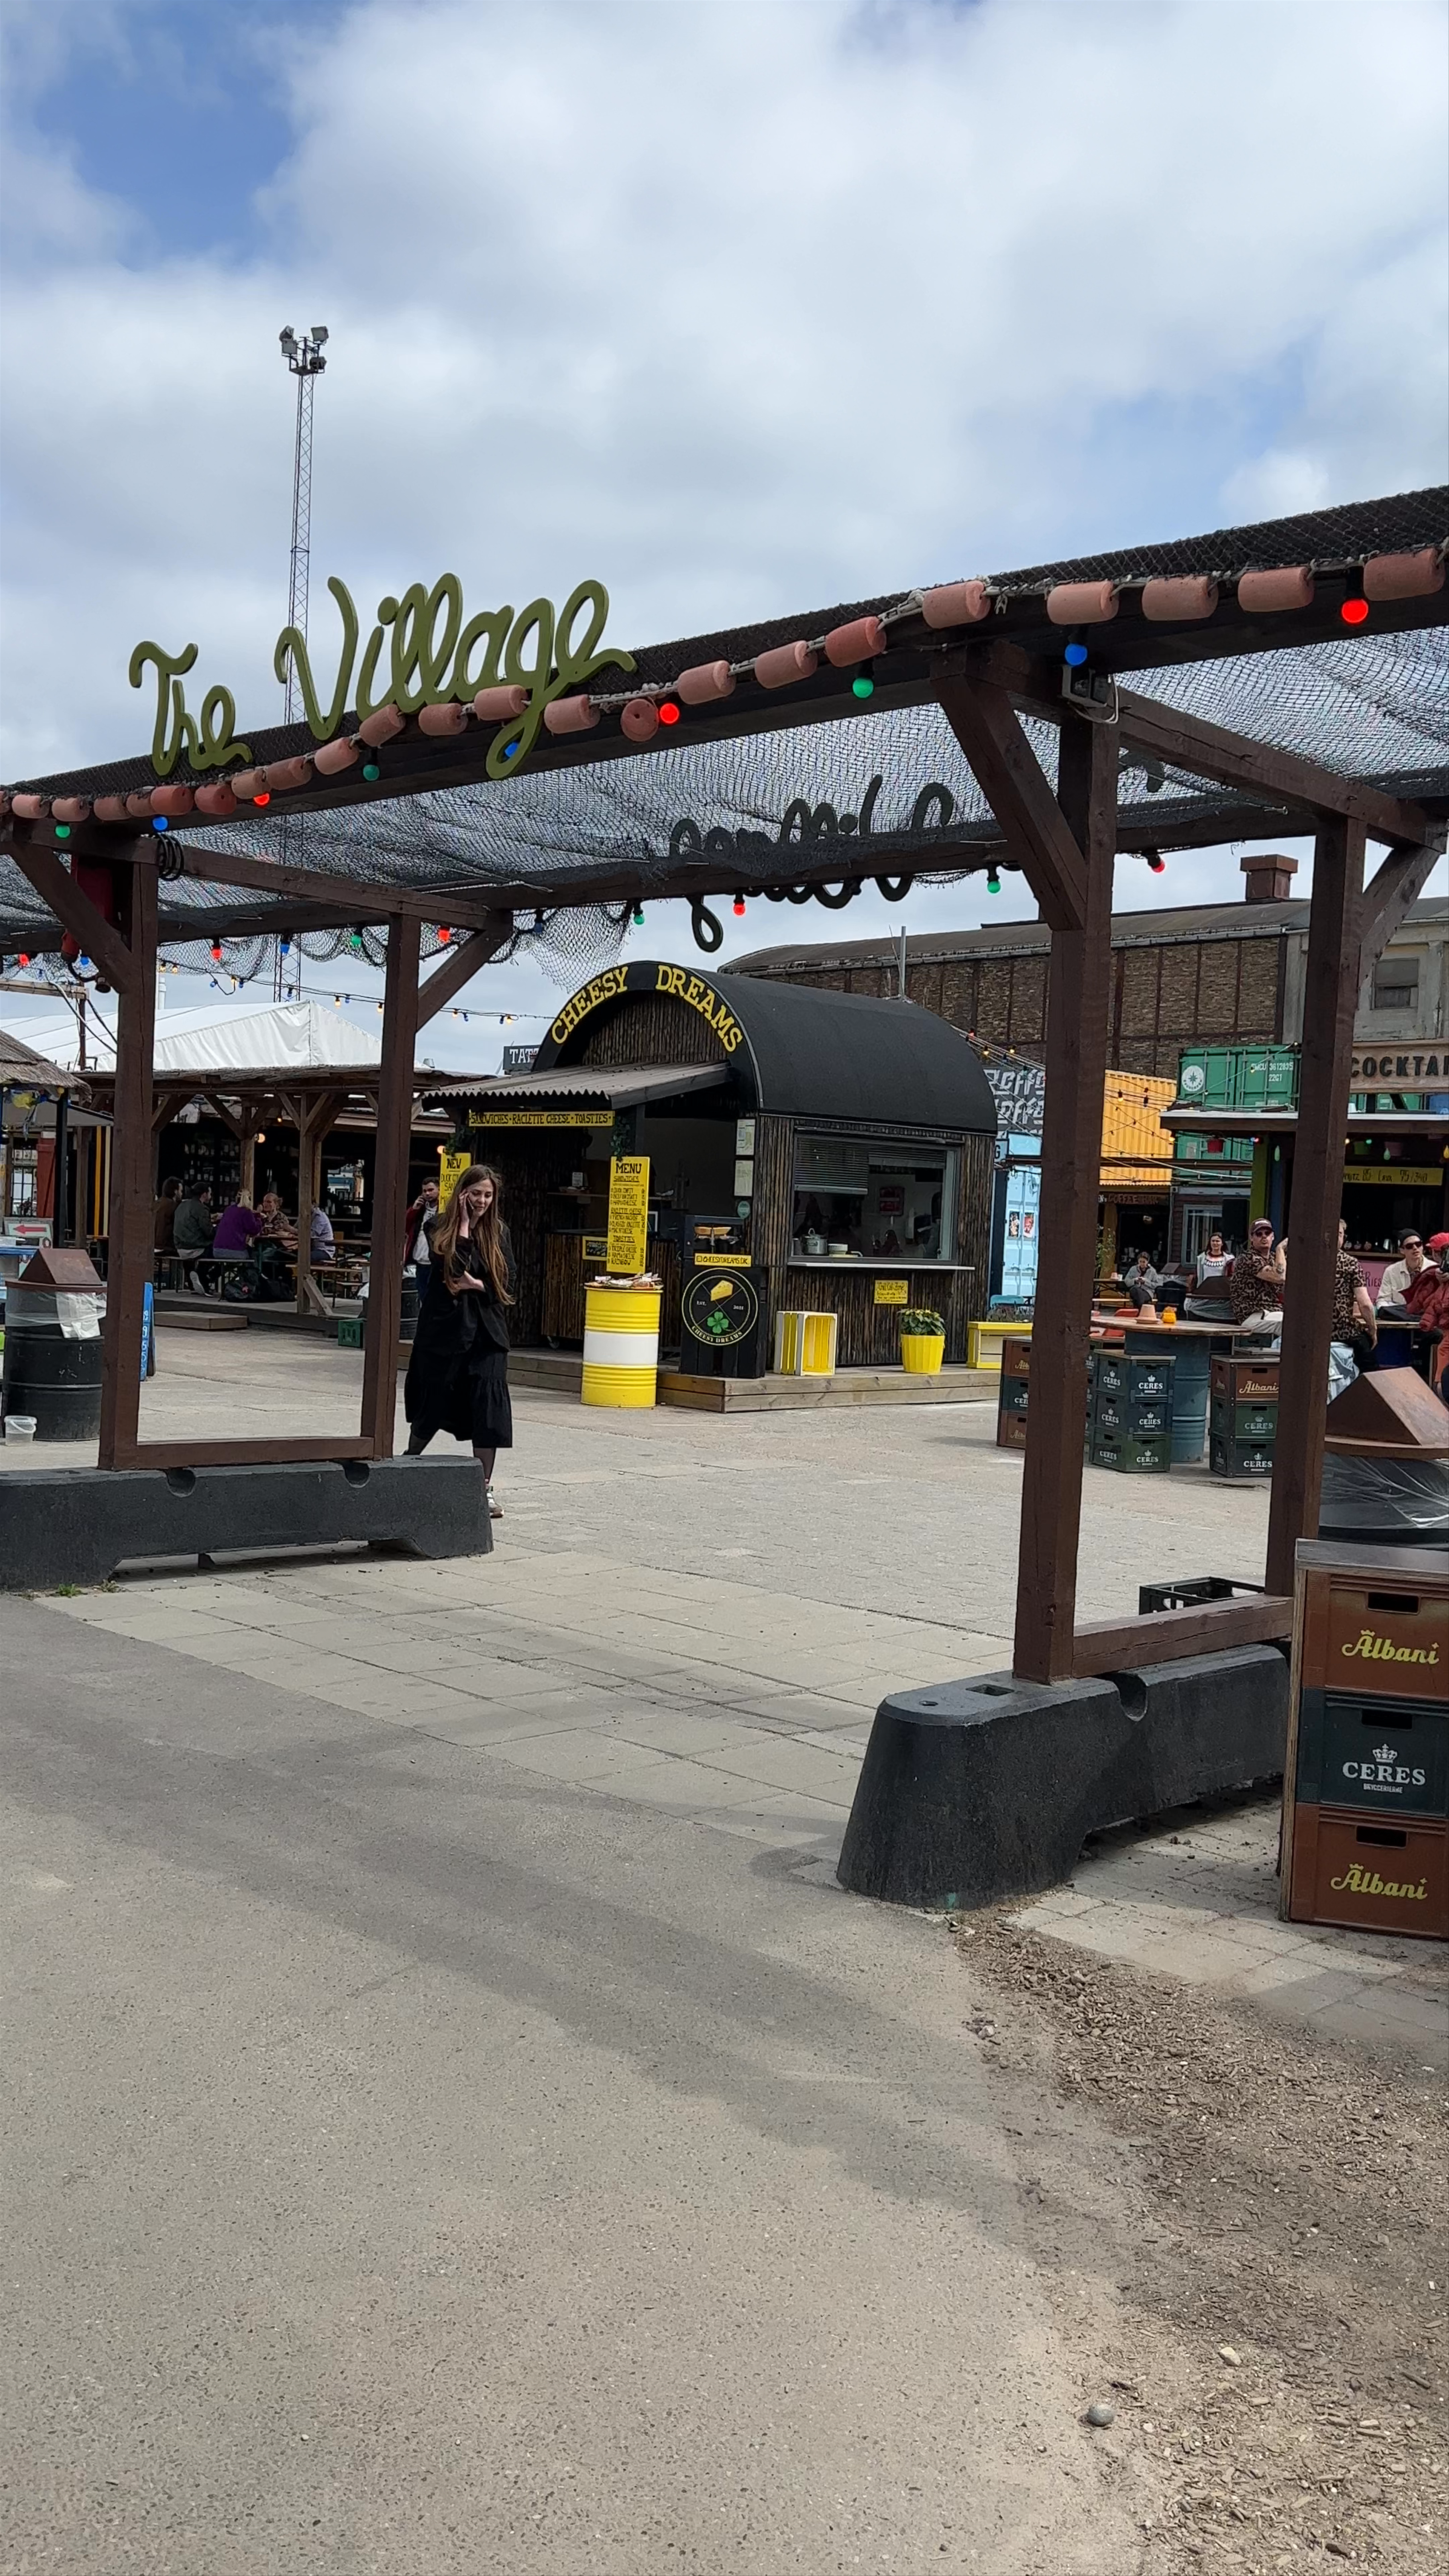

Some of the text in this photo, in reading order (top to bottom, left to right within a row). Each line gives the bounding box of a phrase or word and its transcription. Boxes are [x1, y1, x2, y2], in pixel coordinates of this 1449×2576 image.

[129, 573, 637, 779] The Village
[551, 965, 743, 1052] CHEESY DREAMS
[512, 1114, 544, 1124] RACLETTE
[546, 1114, 571, 1124] CHEESE
[575, 1113, 608, 1123] TOASTIES
[447, 1158, 461, 1169] NEW
[615, 1163, 642, 1173] MENU
[1103, 1376, 1120, 1386] CERES
[1239, 1381, 1279, 1393] Albani
[1101, 1414, 1119, 1424] CERES
[1100, 1451, 1117, 1460] CERES
[1341, 1632, 1440, 1664] Albani
[1343, 1762, 1426, 1786] CERES
[1331, 1866, 1428, 1900] Albani
